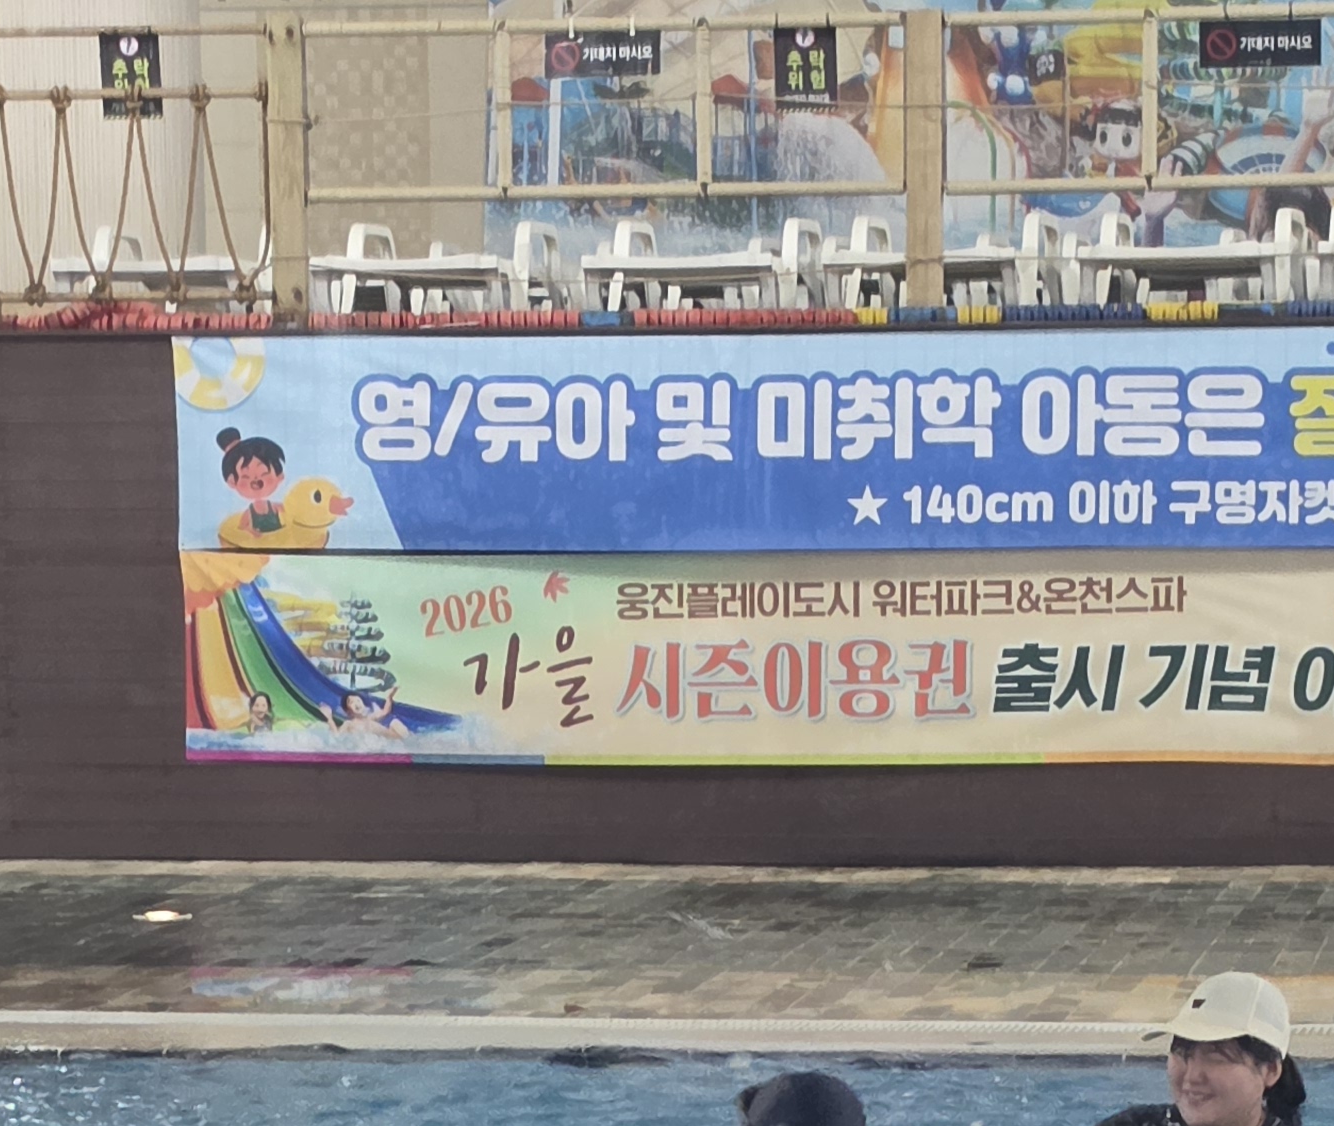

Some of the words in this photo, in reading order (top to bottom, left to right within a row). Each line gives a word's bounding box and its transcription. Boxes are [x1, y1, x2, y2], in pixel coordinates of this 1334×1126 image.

[583, 46, 616, 61] 기대지
[619, 45, 653, 61] 마시오
[1240, 35, 1274, 51] 기대지
[1278, 35, 1312, 51] 마시오
[359, 381, 636, 462] 영/유아
[655, 379, 734, 462] 및
[757, 375, 1001, 460] 미취학
[1022, 372, 1265, 456] 아동은
[903, 484, 1055, 524] 140cm
[1069, 479, 1157, 525] 이하
[419, 585, 513, 638] 2026
[616, 580, 861, 620] 웅진플레이도시
[872, 576, 1188, 617] 워터파크&온천스파
[463, 625, 594, 728] 가을
[615, 637, 972, 721] 시즌이용권
[993, 643, 1125, 714] 출시
[1139, 643, 1275, 712] 기념
